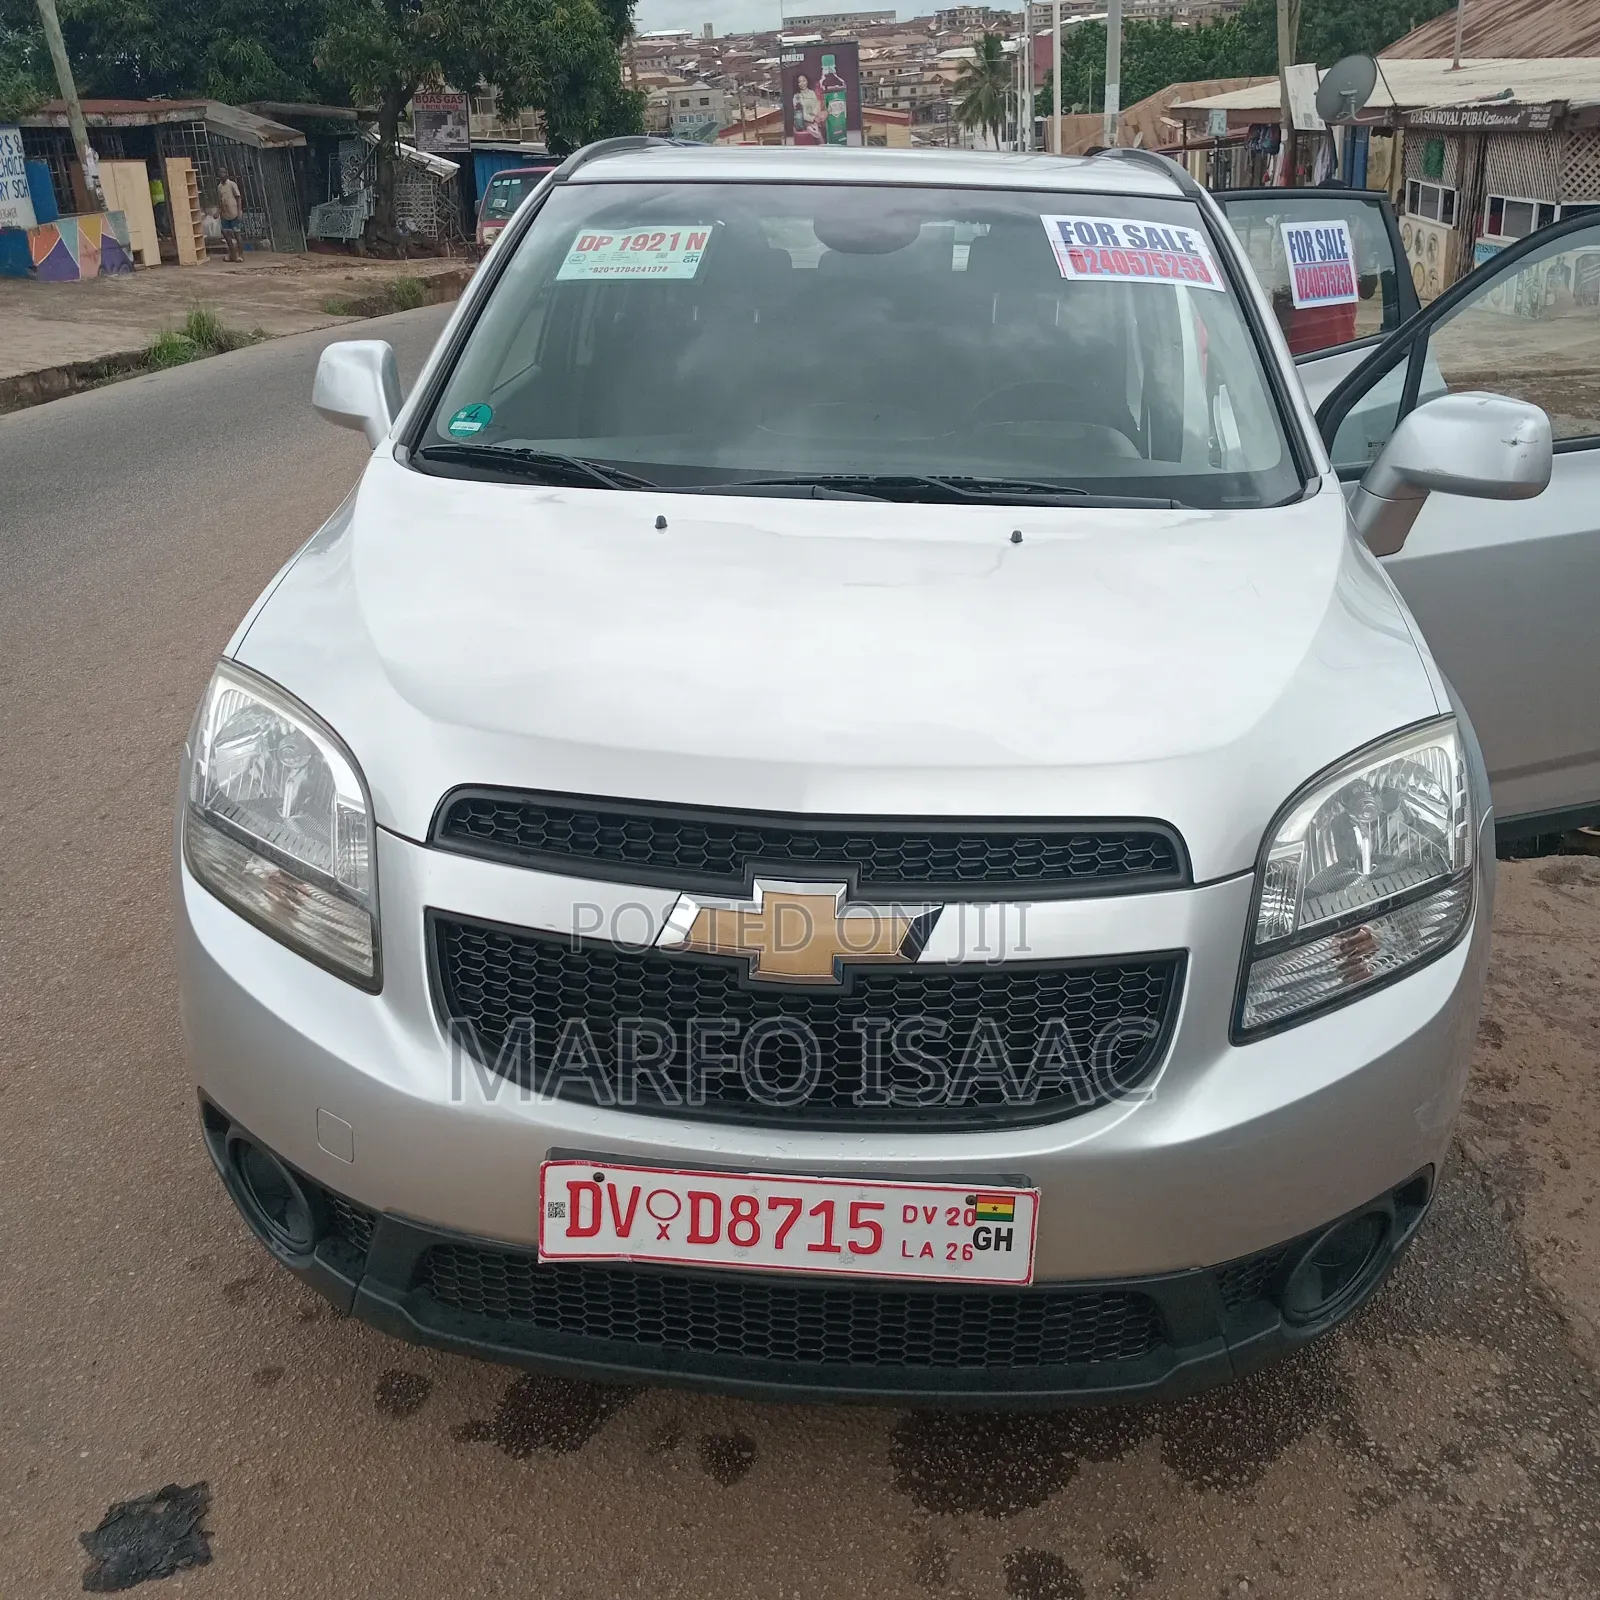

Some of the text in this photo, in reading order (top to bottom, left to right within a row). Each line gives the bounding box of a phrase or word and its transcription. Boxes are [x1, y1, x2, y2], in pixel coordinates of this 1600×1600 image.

[415, 95, 464, 103] BOAS GAS
[575, 231, 707, 252] DP 1921 N
[1056, 221, 1197, 254] FOR SALE
[1287, 228, 1349, 264] FOR SALE
[1067, 248, 1213, 284] 0240575253
[565, 1180, 642, 1238] DV
[687, 1190, 885, 1256] D8715
[902, 1204, 976, 1227] DV 20
[901, 1239, 974, 1261] LA 26
[972, 1226, 1014, 1252] GH
